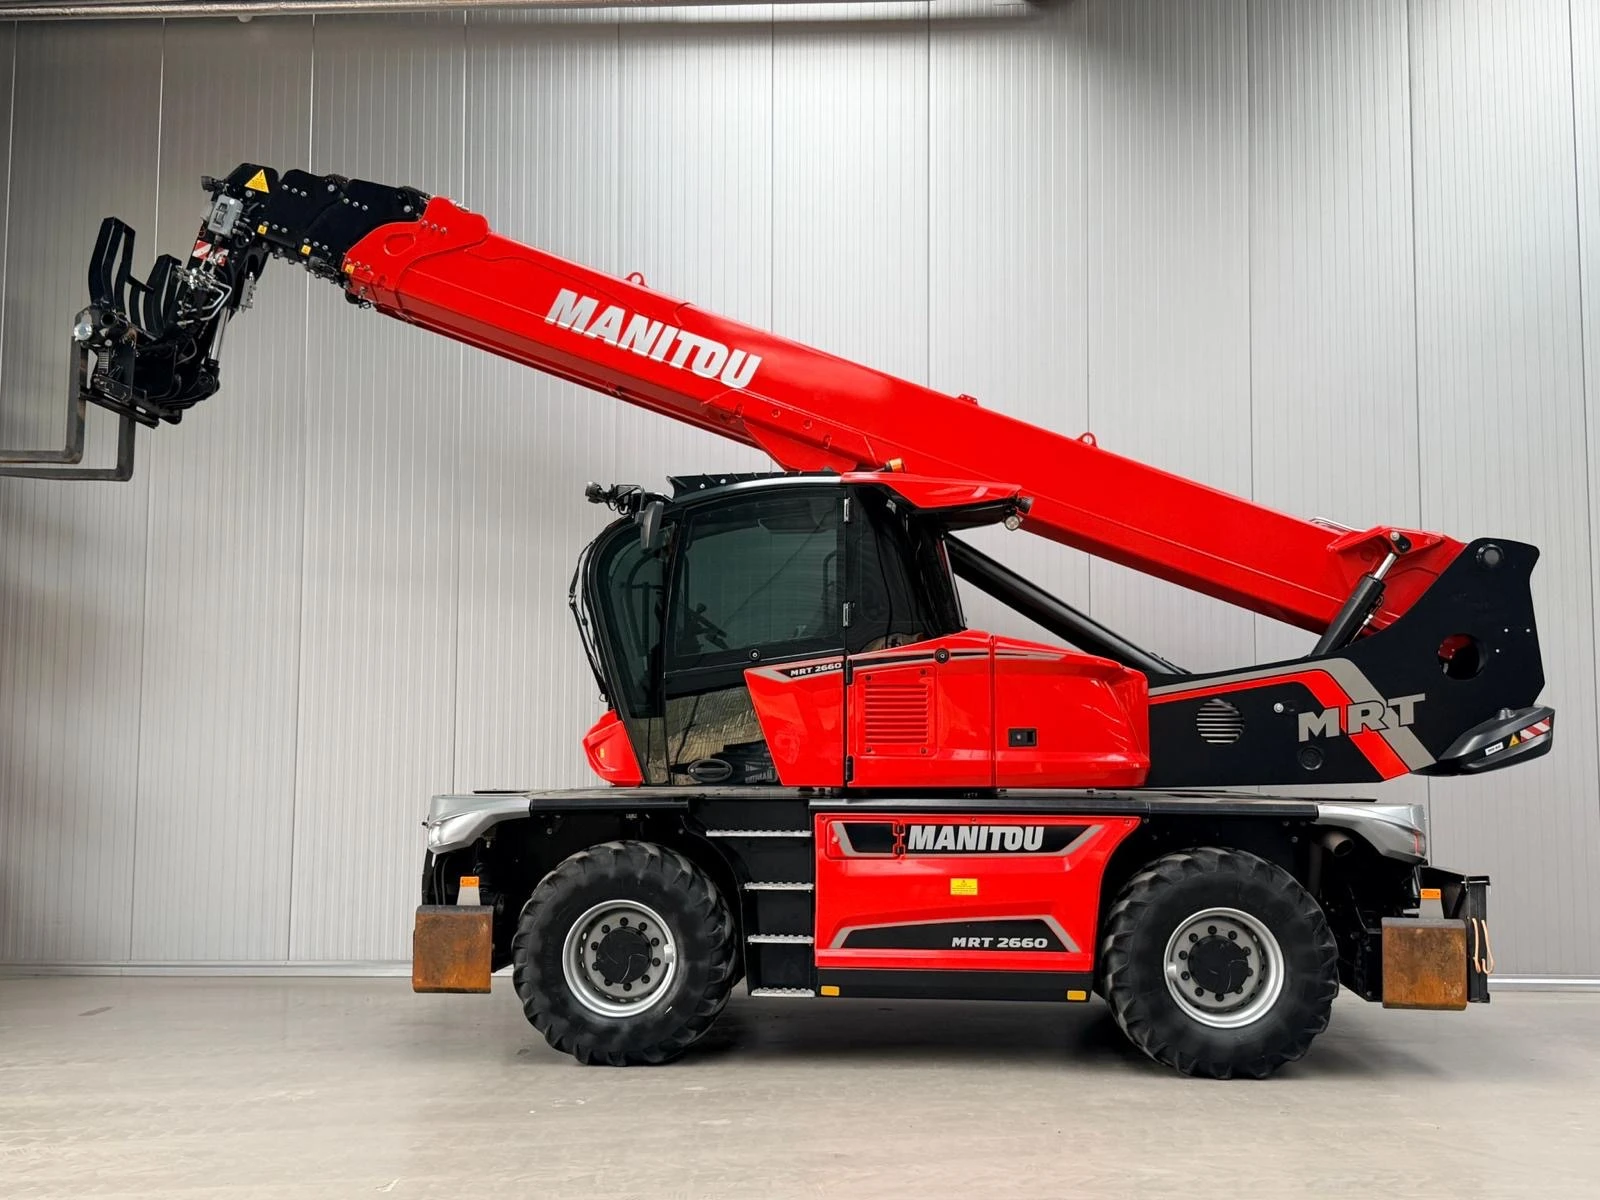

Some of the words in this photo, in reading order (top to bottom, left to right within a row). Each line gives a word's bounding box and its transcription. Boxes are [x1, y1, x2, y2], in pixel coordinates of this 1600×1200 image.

[545, 288, 763, 388] MANITOU
[790, 667, 813, 676] MRT
[815, 662, 842, 672] 2660
[1298, 693, 1426, 743] MRT
[907, 825, 1045, 851] MANITOU
[951, 937, 994, 948] MRT
[997, 937, 1048, 949] 2660
